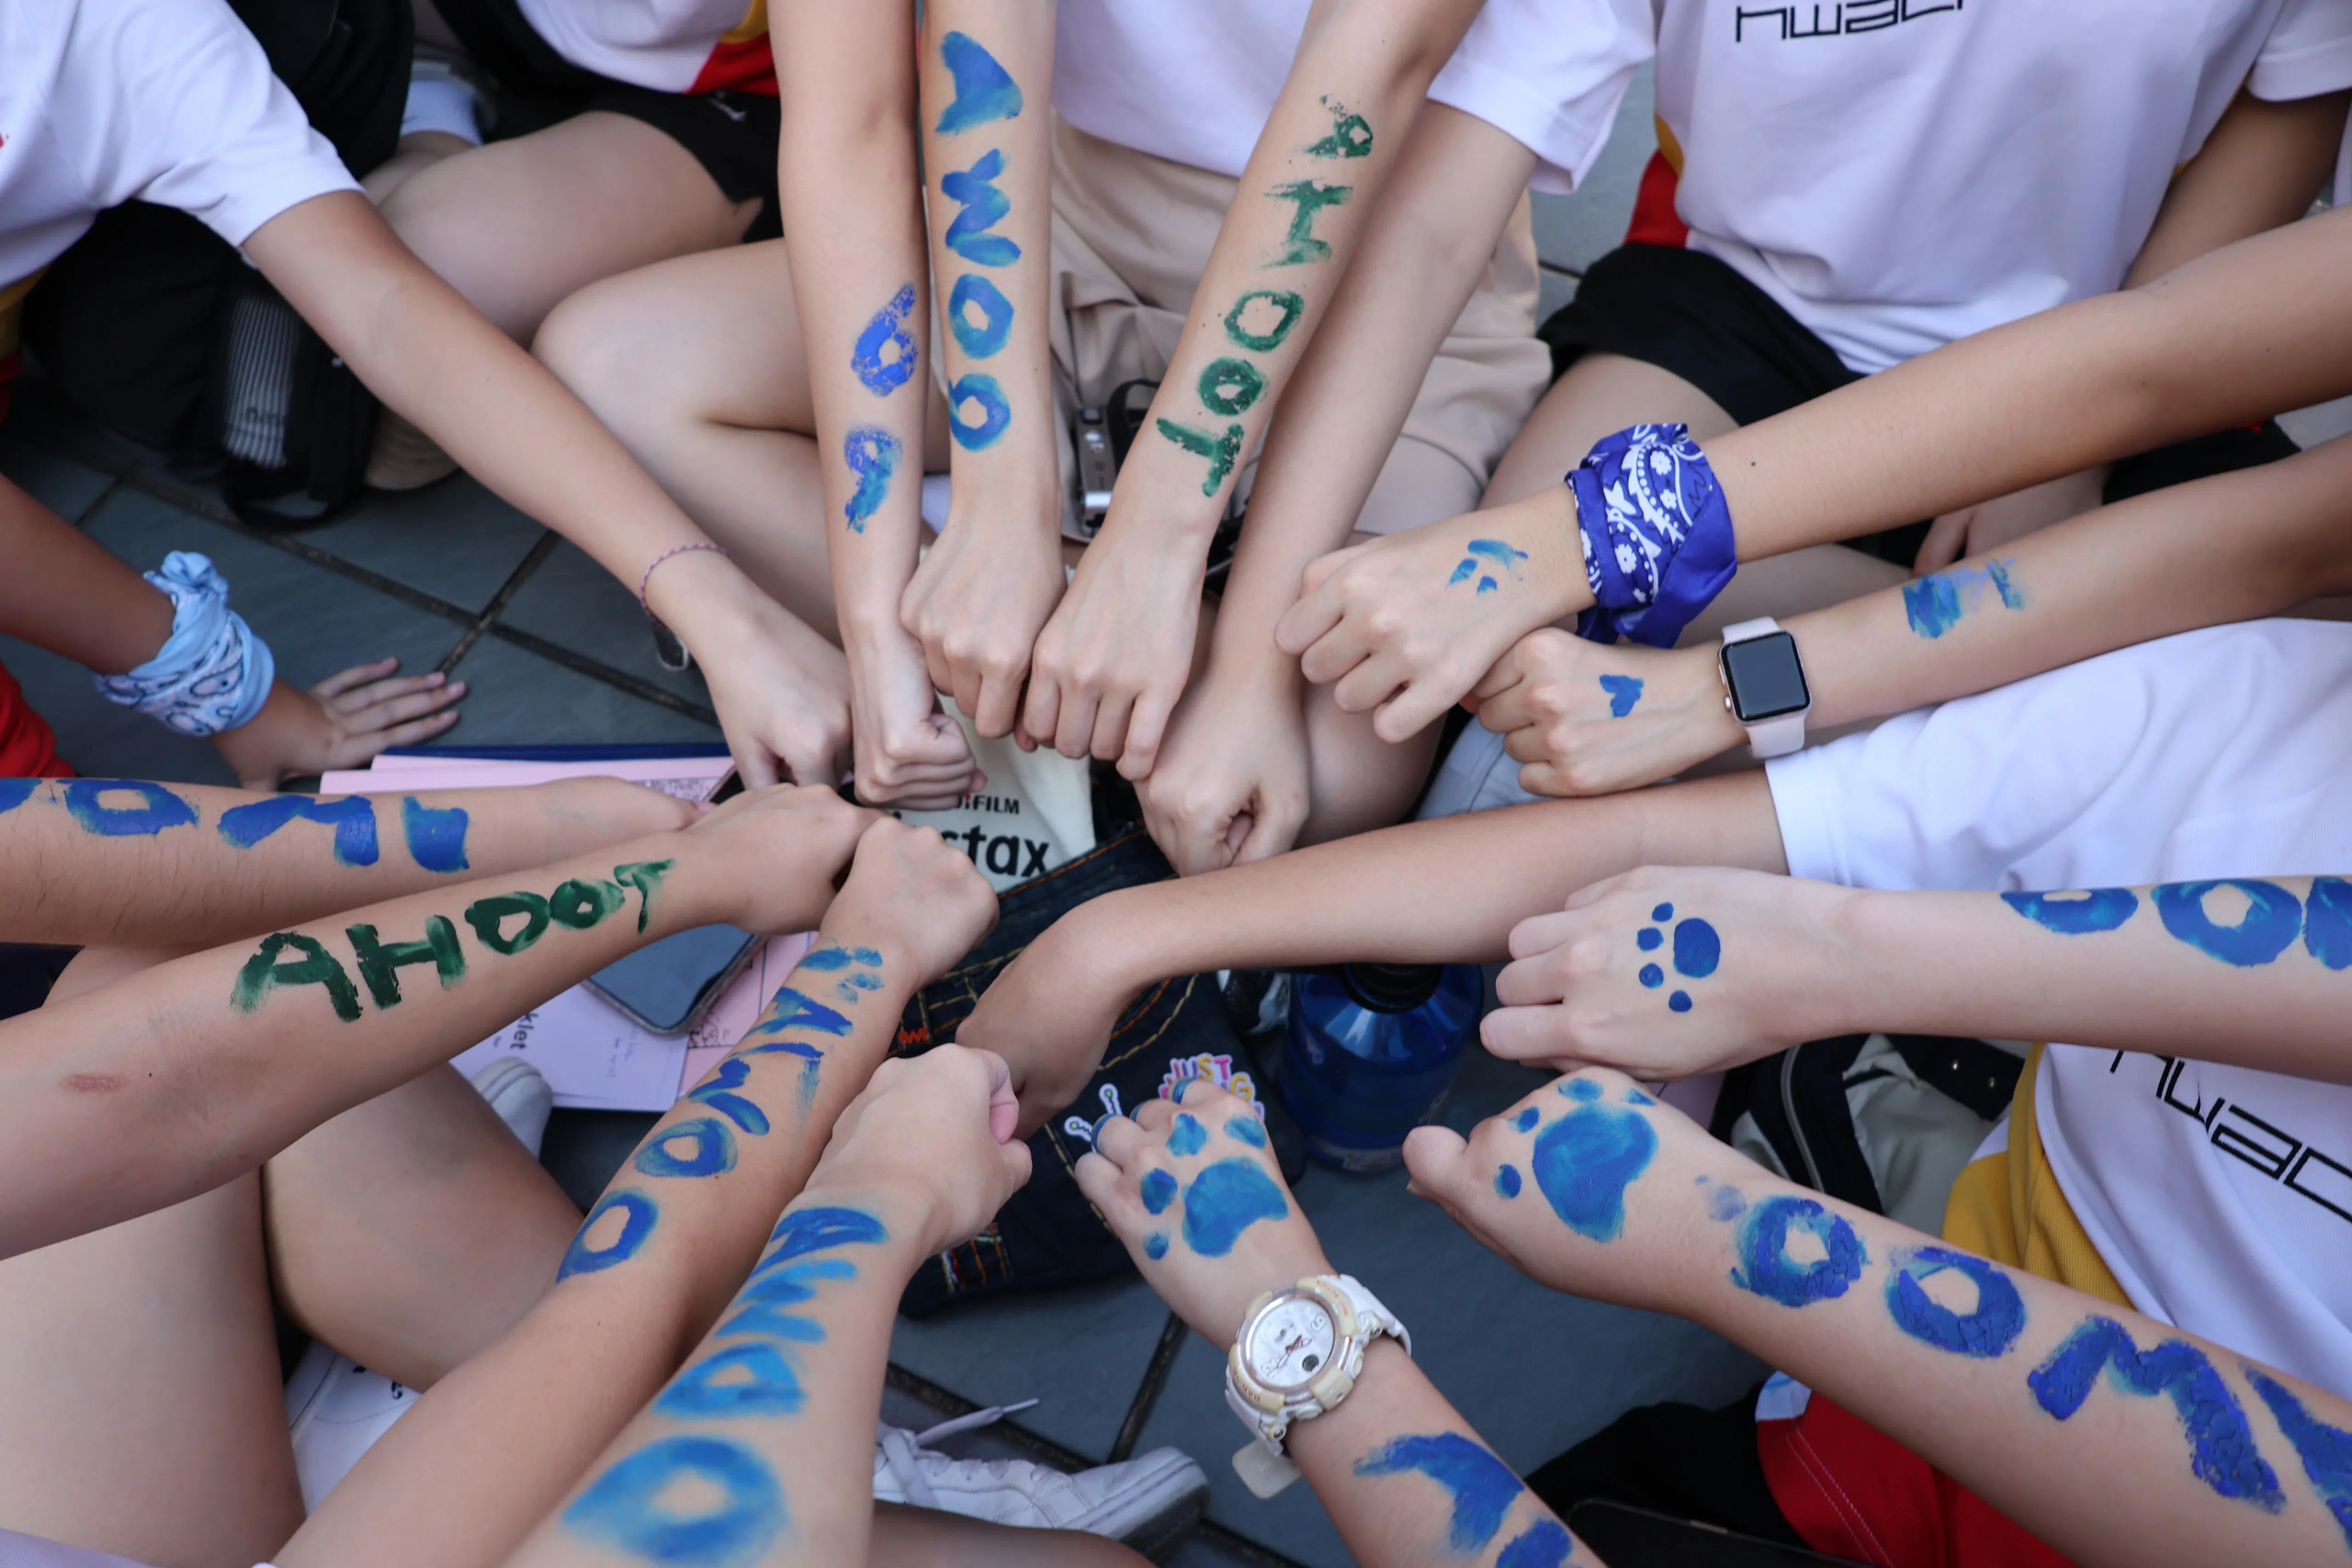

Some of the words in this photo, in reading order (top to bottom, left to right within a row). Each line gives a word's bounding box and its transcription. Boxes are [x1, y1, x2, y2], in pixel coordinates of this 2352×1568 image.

[955, 795, 1019, 814] JIFILM
[231, 859, 675, 1023] AHOOT
[509, 1013, 538, 1050] klet
